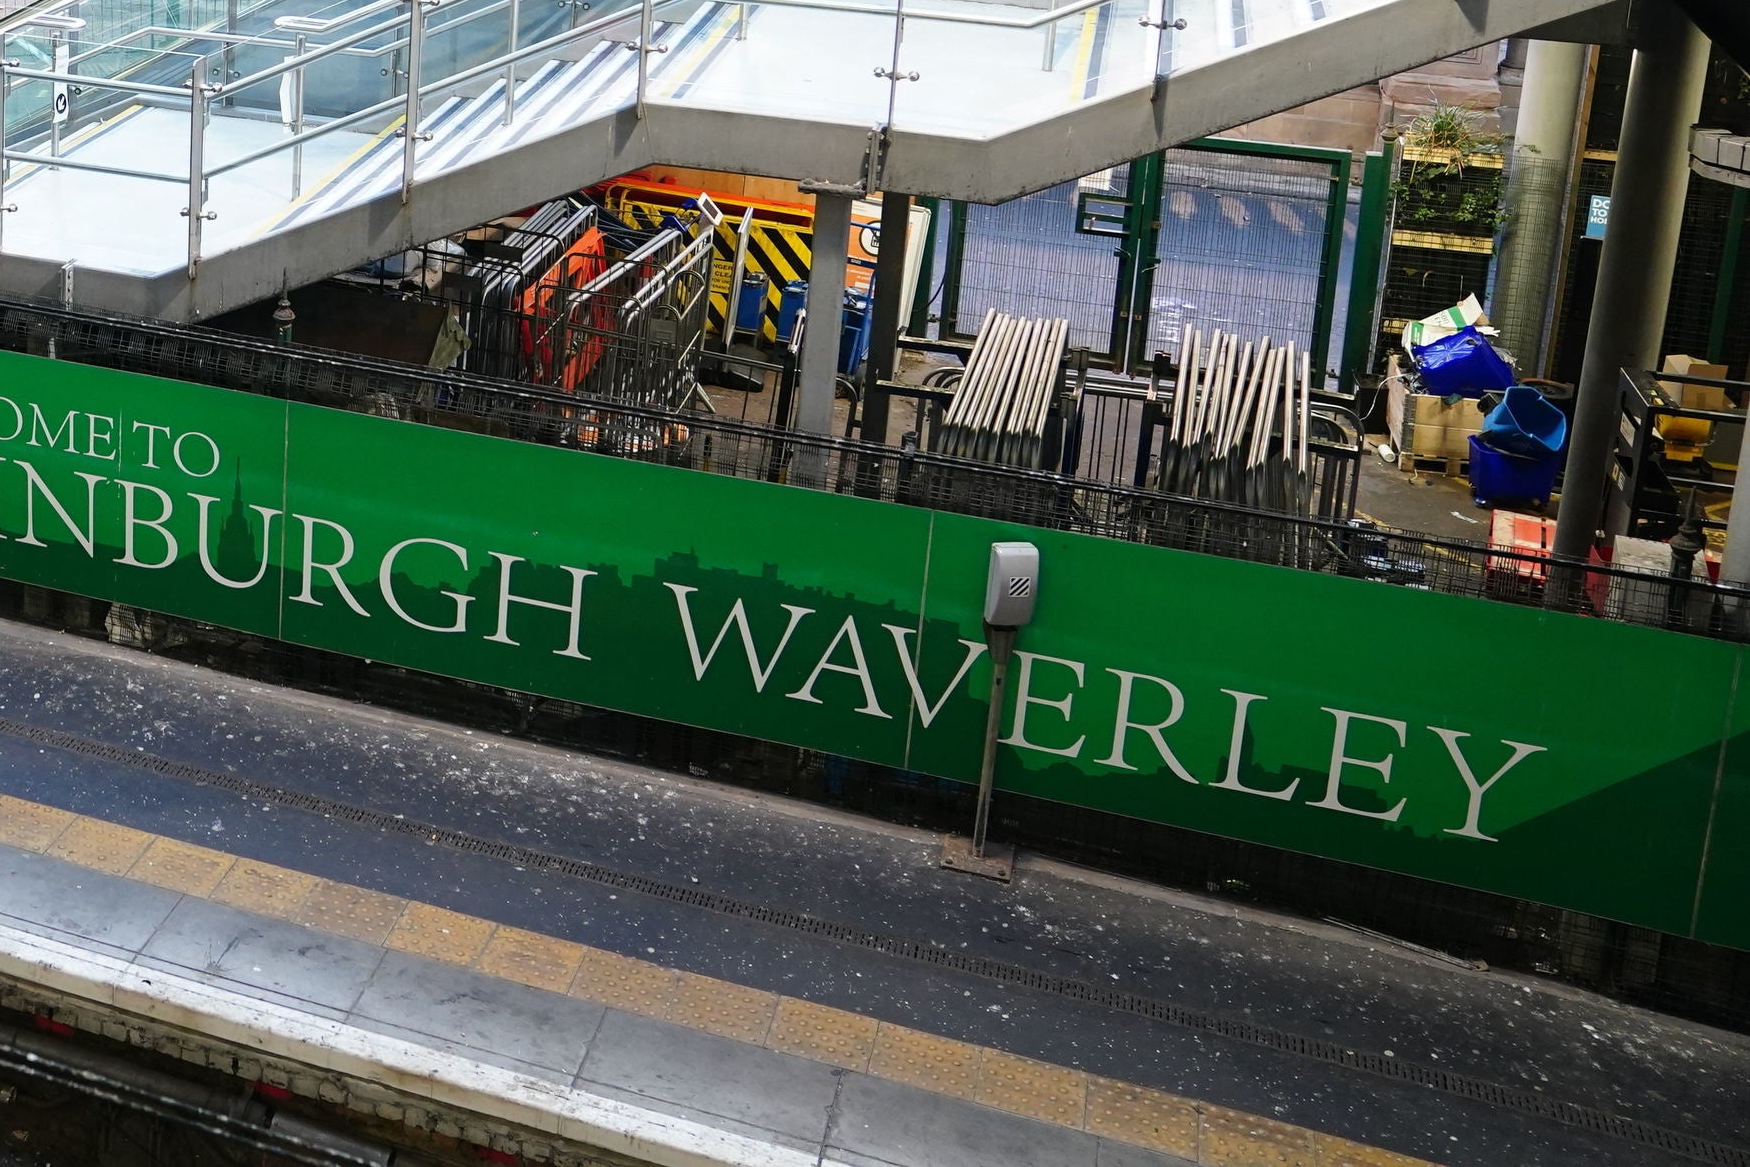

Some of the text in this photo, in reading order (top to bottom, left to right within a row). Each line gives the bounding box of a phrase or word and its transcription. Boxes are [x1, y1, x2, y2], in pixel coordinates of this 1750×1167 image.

[1592, 208, 1608, 218] TO
[132, 420, 220, 478] TO
[662, 581, 1548, 842] WAVERLEY
